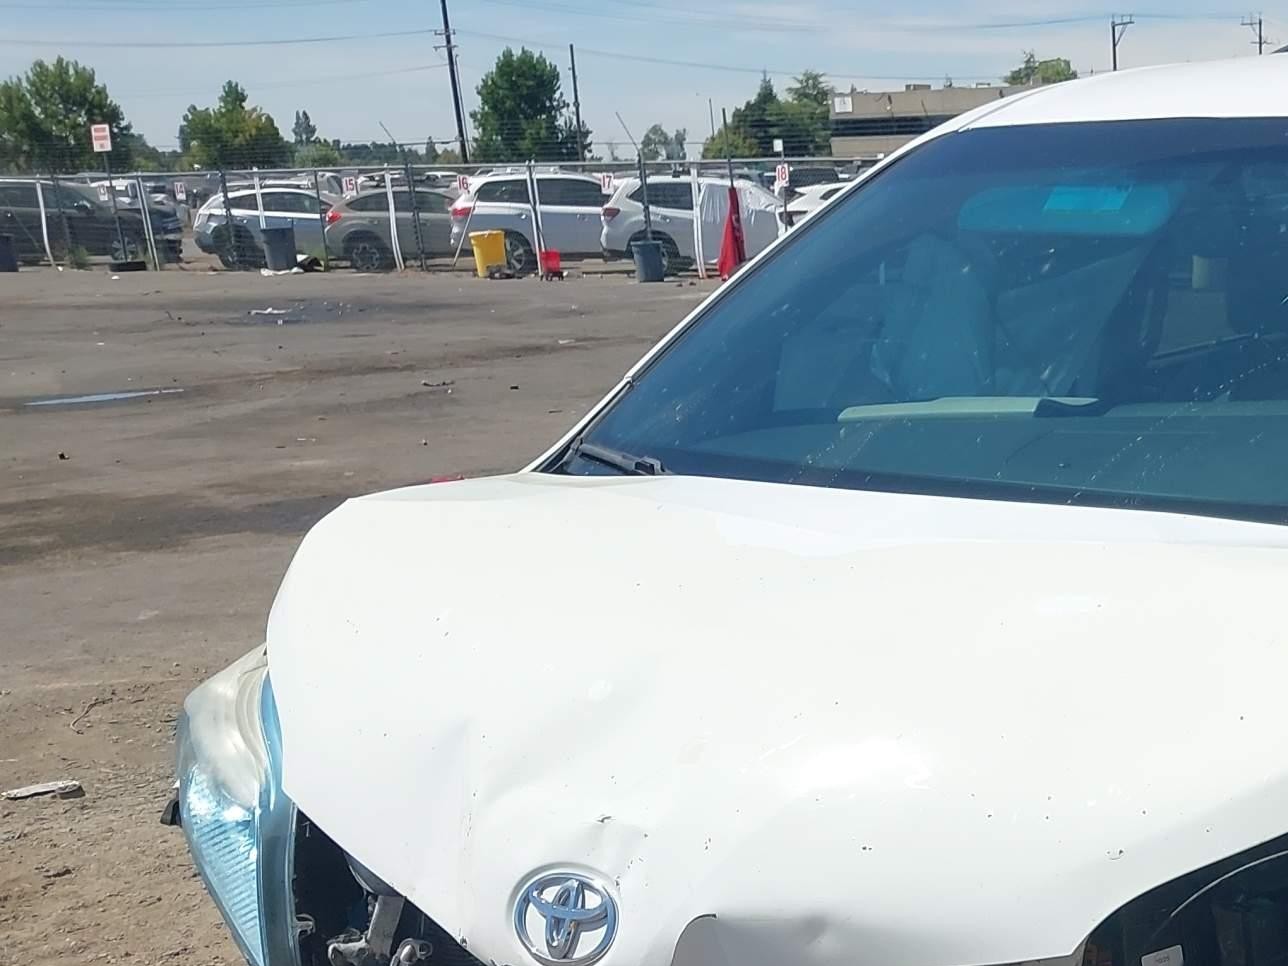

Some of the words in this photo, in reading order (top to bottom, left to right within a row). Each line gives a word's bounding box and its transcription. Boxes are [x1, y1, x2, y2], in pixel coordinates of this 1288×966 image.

[777, 166, 787, 181] 18
[345, 177, 354, 191] 15
[458, 176, 469, 191] 16
[602, 174, 612, 189] 17
